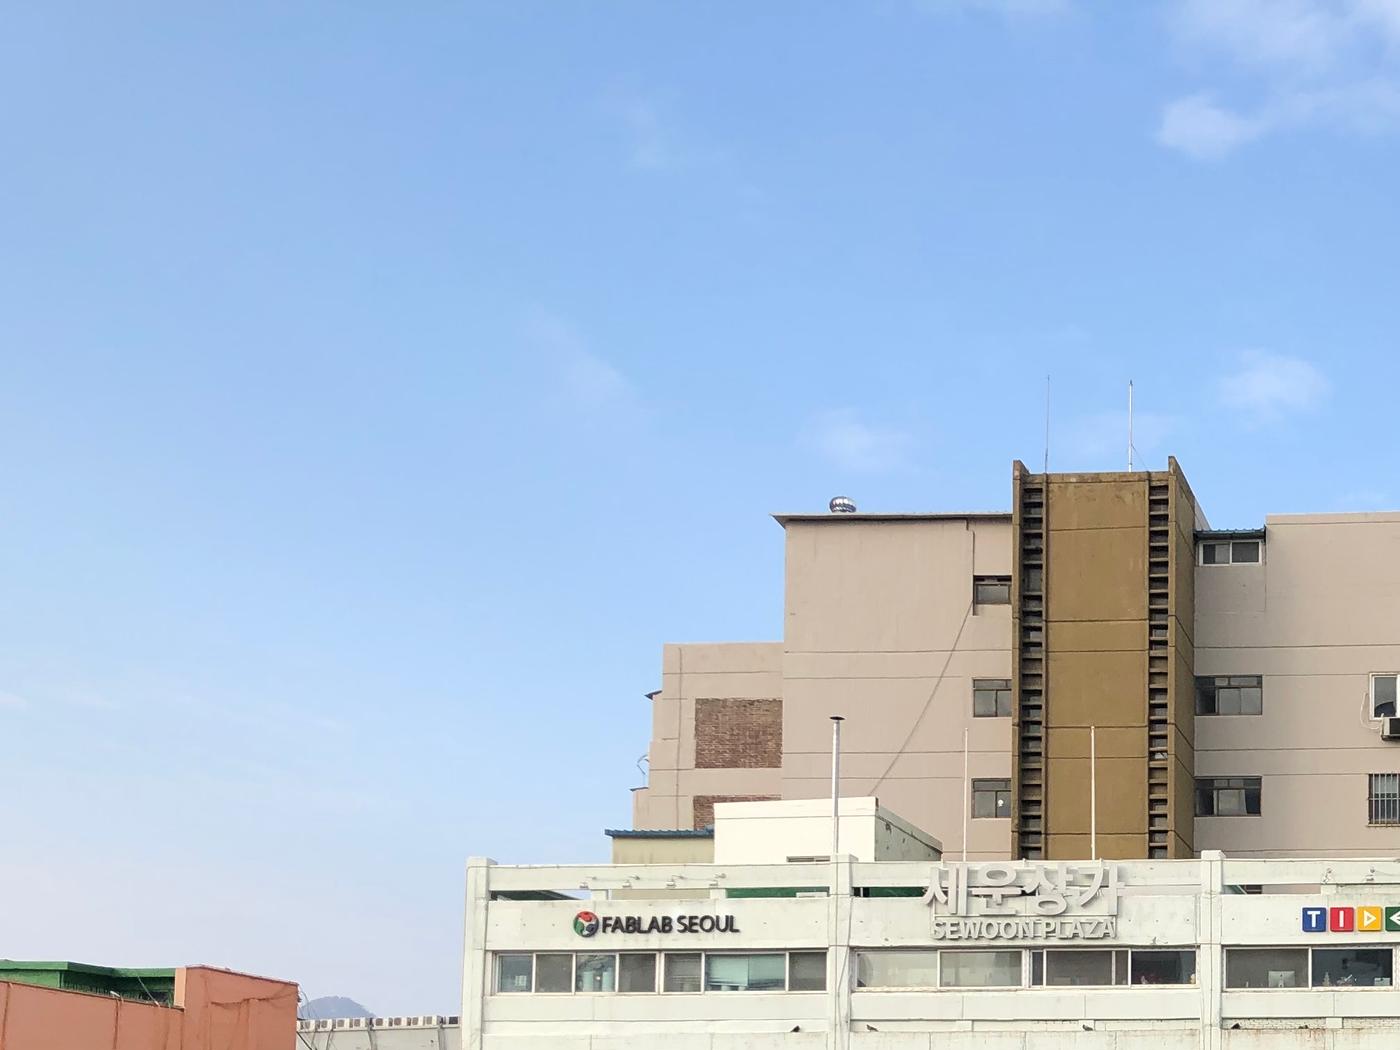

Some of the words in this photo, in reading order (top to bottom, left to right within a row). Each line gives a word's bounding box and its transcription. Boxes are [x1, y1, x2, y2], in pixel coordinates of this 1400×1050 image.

[924, 863, 1126, 917] 세운상가
[601, 915, 674, 934] FABLAB
[676, 914, 741, 934] SEOUL
[932, 918, 1035, 940] SEWOON
[1042, 917, 1118, 940] PLAZA
